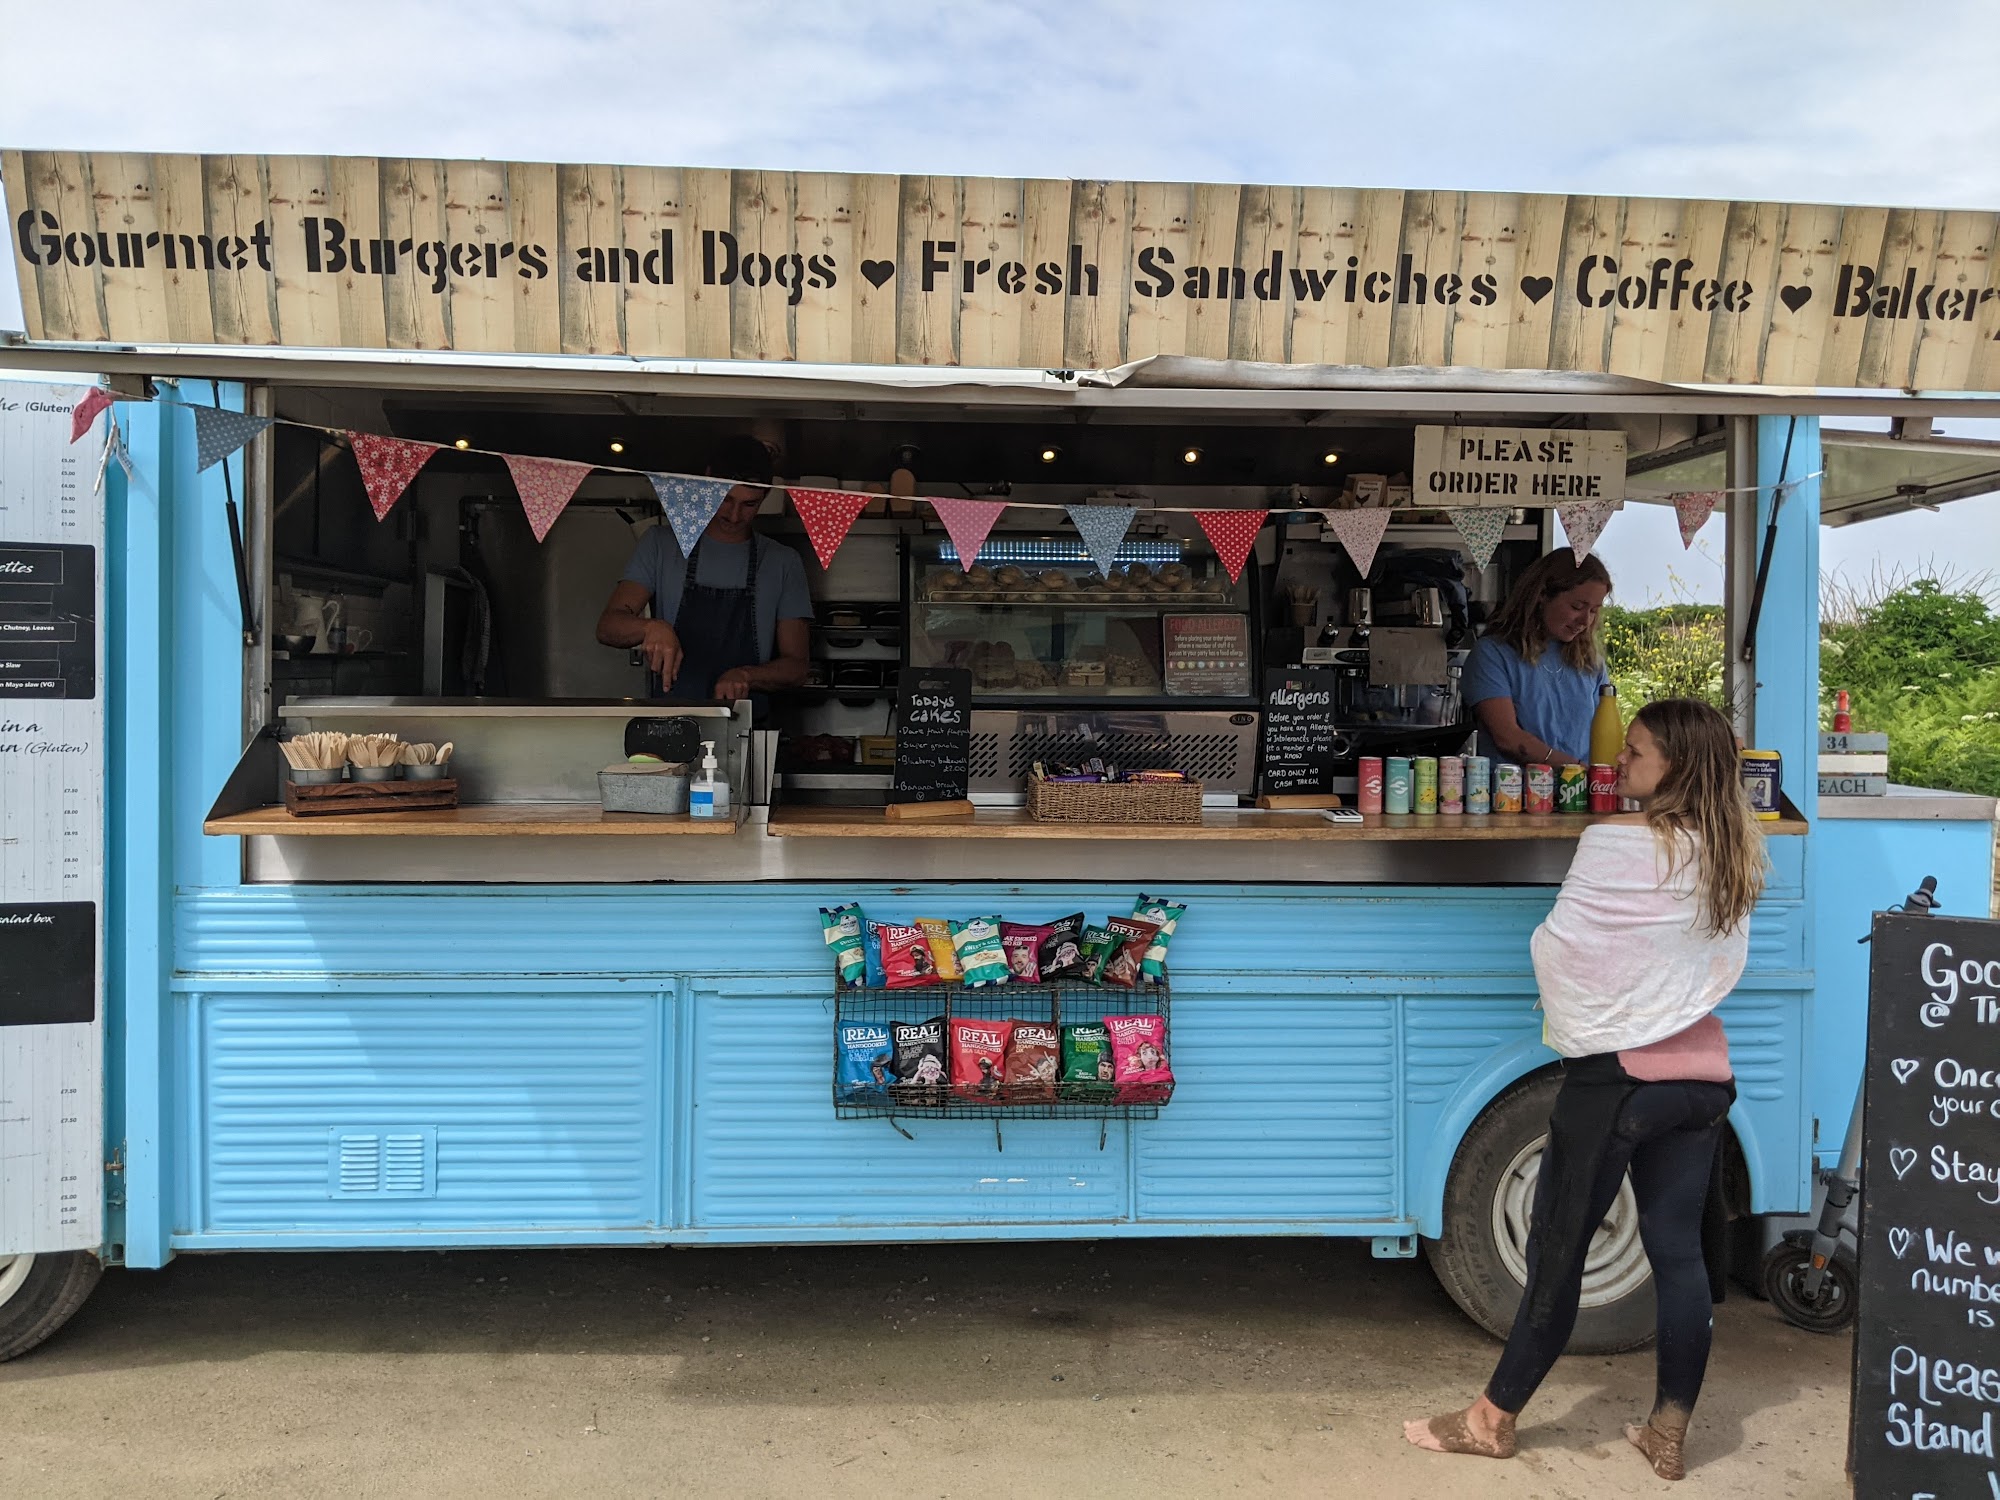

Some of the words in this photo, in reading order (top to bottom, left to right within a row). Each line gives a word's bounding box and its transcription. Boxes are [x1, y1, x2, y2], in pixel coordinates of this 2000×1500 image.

[17, 209, 272, 272] Gourmet
[304, 217, 548, 294] Burgers
[576, 229, 674, 285] and
[702, 230, 837, 306] Dogs
[921, 241, 1098, 297] Fresh
[1134, 246, 1498, 306] Sandwiches
[1576, 254, 1754, 313] Coffee
[1833, 264, 2000, 341] Baker
[25, 401, 75, 414] (Gluten)
[1460, 438, 1574, 463] PLEASE
[1429, 471, 1518, 494] ORDER
[1532, 473, 1601, 497] HERE
[1269, 688, 1330, 710] Allergens
[1268, 712, 1290, 723] Before
[1292, 715, 1304, 726] you
[902, 727, 924, 735] Dark
[926, 728, 944, 736] fruit
[1266, 726, 1278, 736] you
[1296, 725, 1307, 737] any
[1310, 723, 1334, 734] Allergies
[1313, 735, 1332, 743] please
[1826, 736, 1848, 749] 34
[24, 742, 88, 757] (Gluten)
[903, 741, 928, 749] Super
[930, 742, 959, 752] granola
[1307, 744, 1315, 752] of
[1265, 754, 1281, 762] team
[1268, 769, 1286, 777] CARD
[1288, 769, 1306, 777] ONLY
[900, 781, 935, 791] Banana
[935, 780, 958, 788] bread
[1274, 780, 1292, 789] CASH
[1558, 774, 1587, 804] Sprit
[1589, 780, 1617, 795] Coca-C
[1818, 779, 1867, 794] EACH
[33, 913, 55, 924] box
[889, 927, 921, 940] REA
[964, 943, 981, 951] SWEET
[1920, 1002, 1950, 1028] @
[1113, 1018, 1152, 1031] REAL
[847, 1028, 886, 1041] REAL
[900, 1026, 938, 1040] REAL
[962, 1029, 1000, 1045] REAL
[1018, 1028, 1055, 1040] REAL
[848, 1041, 887, 1049] HANDCOOKED
[1929, 1095, 1985, 1127] your
[1925, 1227, 1976, 1267] We
[1891, 1345, 2000, 1407] Pleas
[1885, 1402, 1994, 1458] Stand
